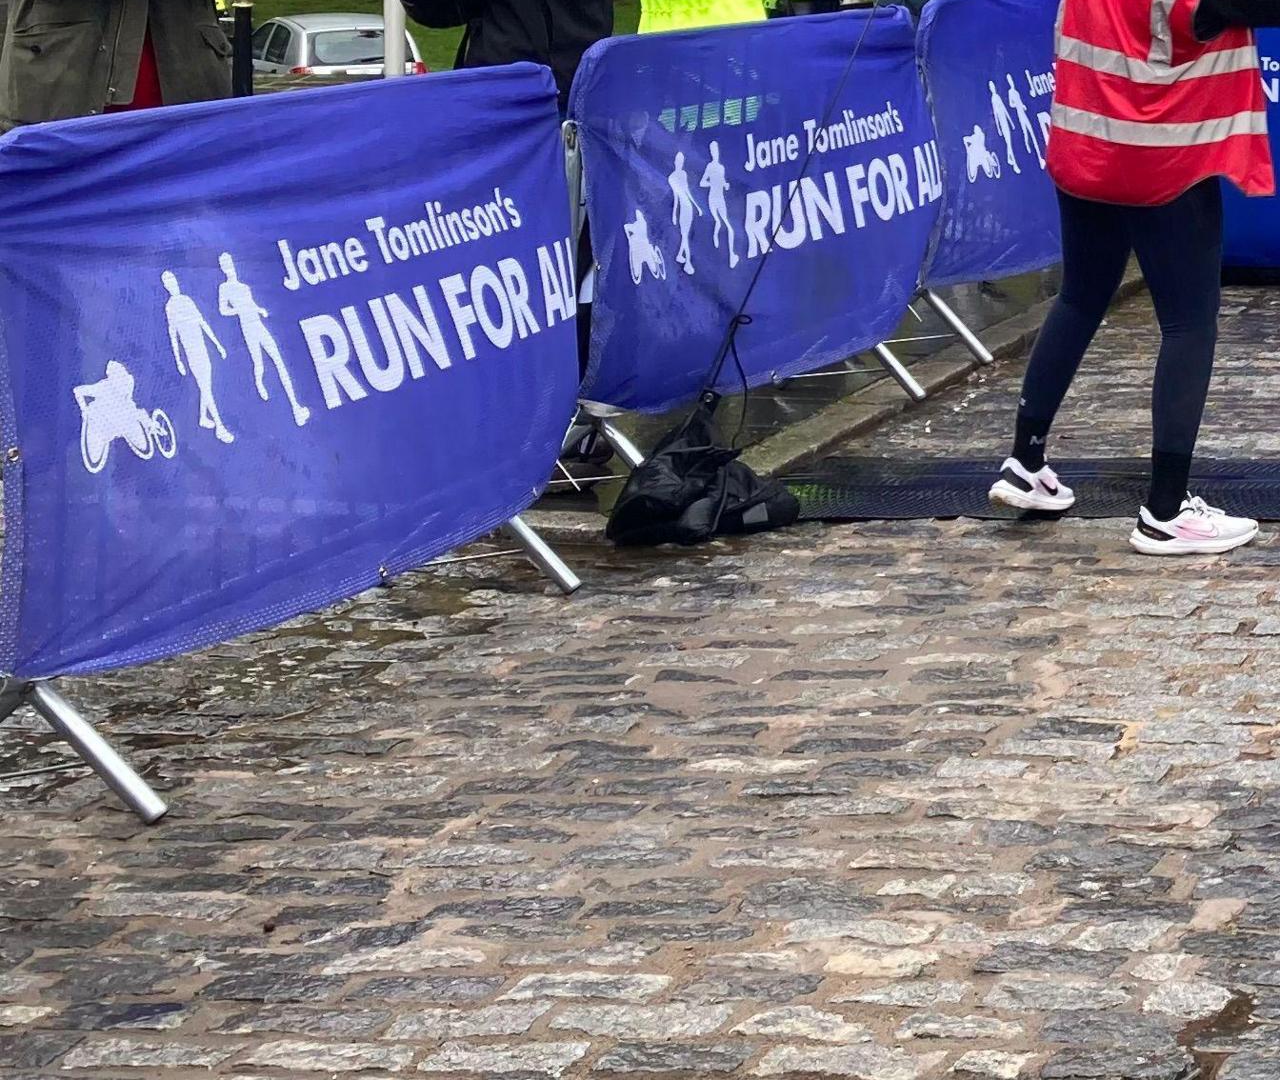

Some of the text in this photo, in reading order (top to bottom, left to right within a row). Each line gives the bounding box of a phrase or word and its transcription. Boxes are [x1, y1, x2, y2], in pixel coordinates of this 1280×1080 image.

[1024, 69, 1057, 98] Jane
[744, 100, 904, 172] Jane Tomlinson's
[277, 187, 522, 291] Jane Tomlinson's
[745, 171, 846, 259] RUN
[845, 153, 915, 229] FOR
[299, 285, 452, 410] RUN
[439, 258, 541, 361] FOR
